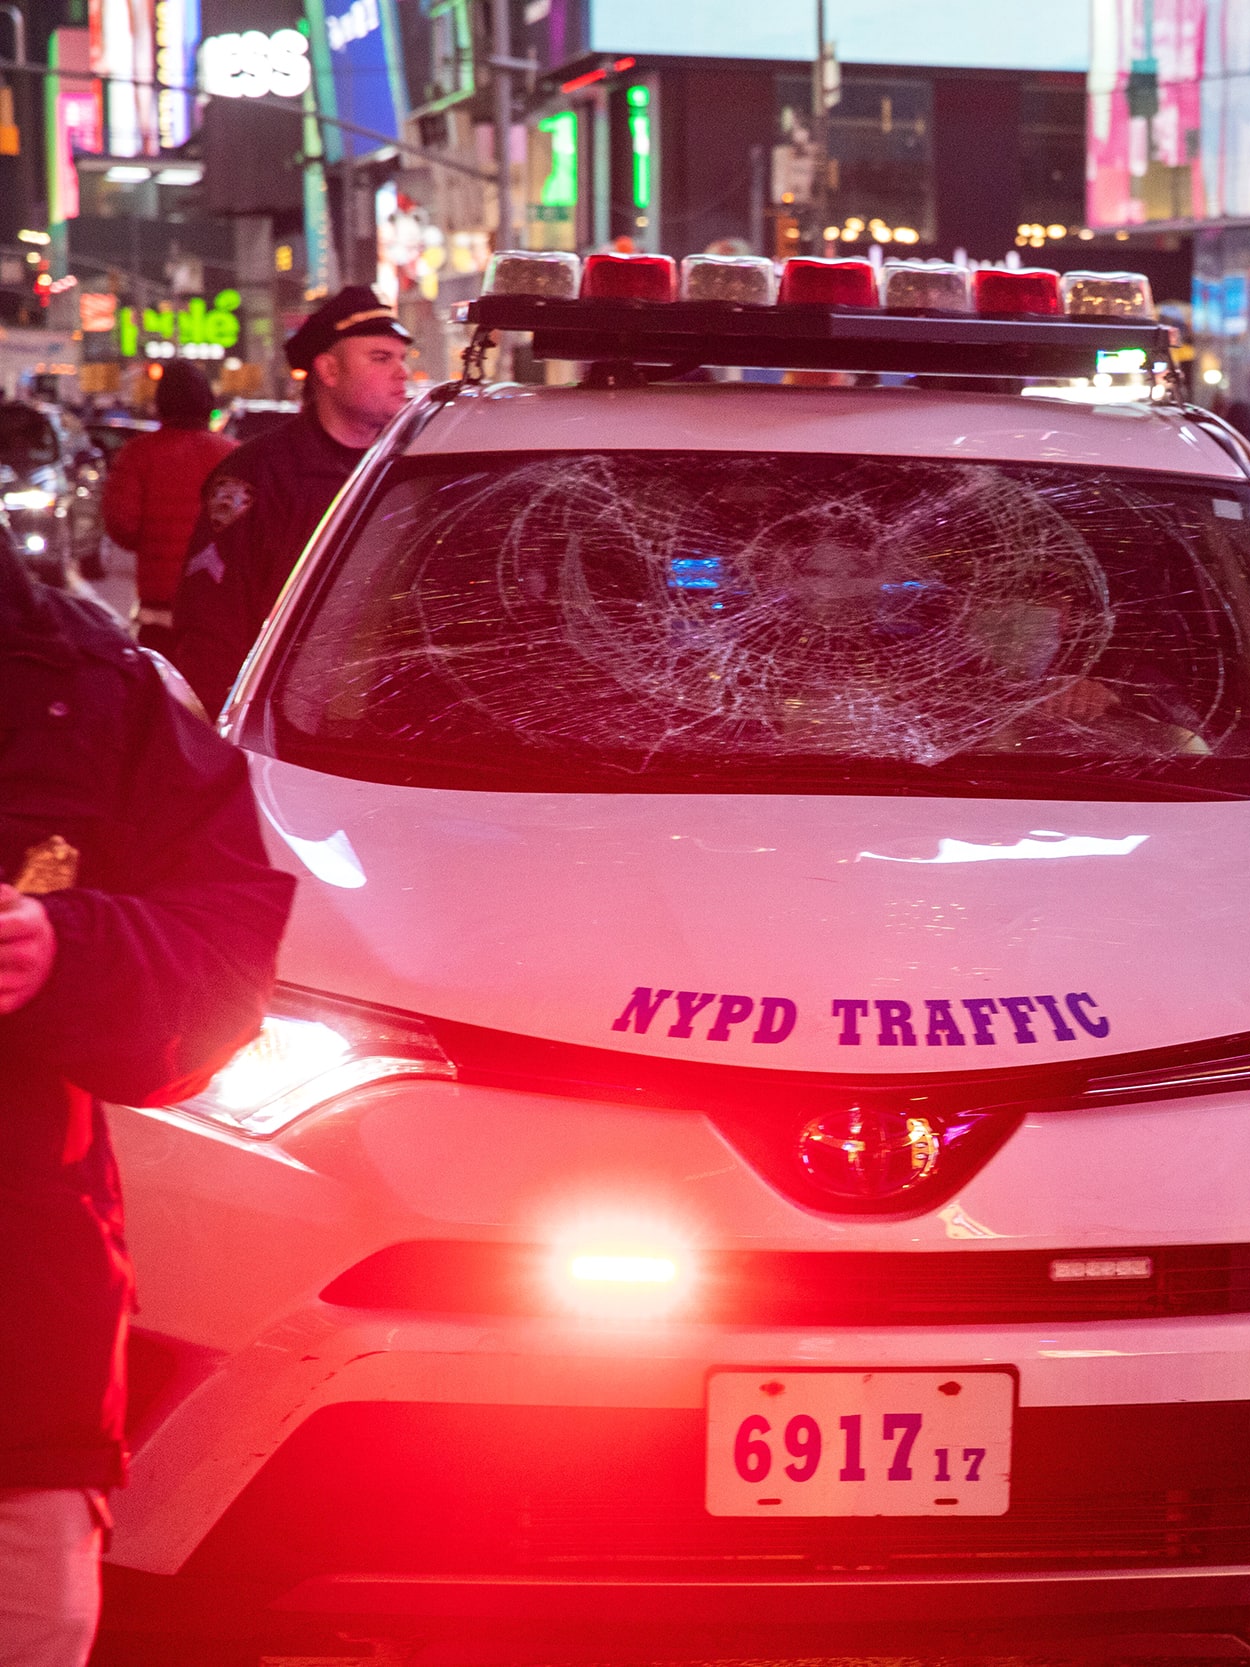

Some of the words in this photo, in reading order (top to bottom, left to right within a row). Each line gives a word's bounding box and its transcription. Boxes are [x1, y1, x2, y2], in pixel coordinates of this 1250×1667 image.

[611, 986, 797, 1044] NYPD
[832, 991, 1110, 1046] TRAFFIC
[734, 1413, 922, 1483] 6917
[934, 1447, 985, 1482] 17
